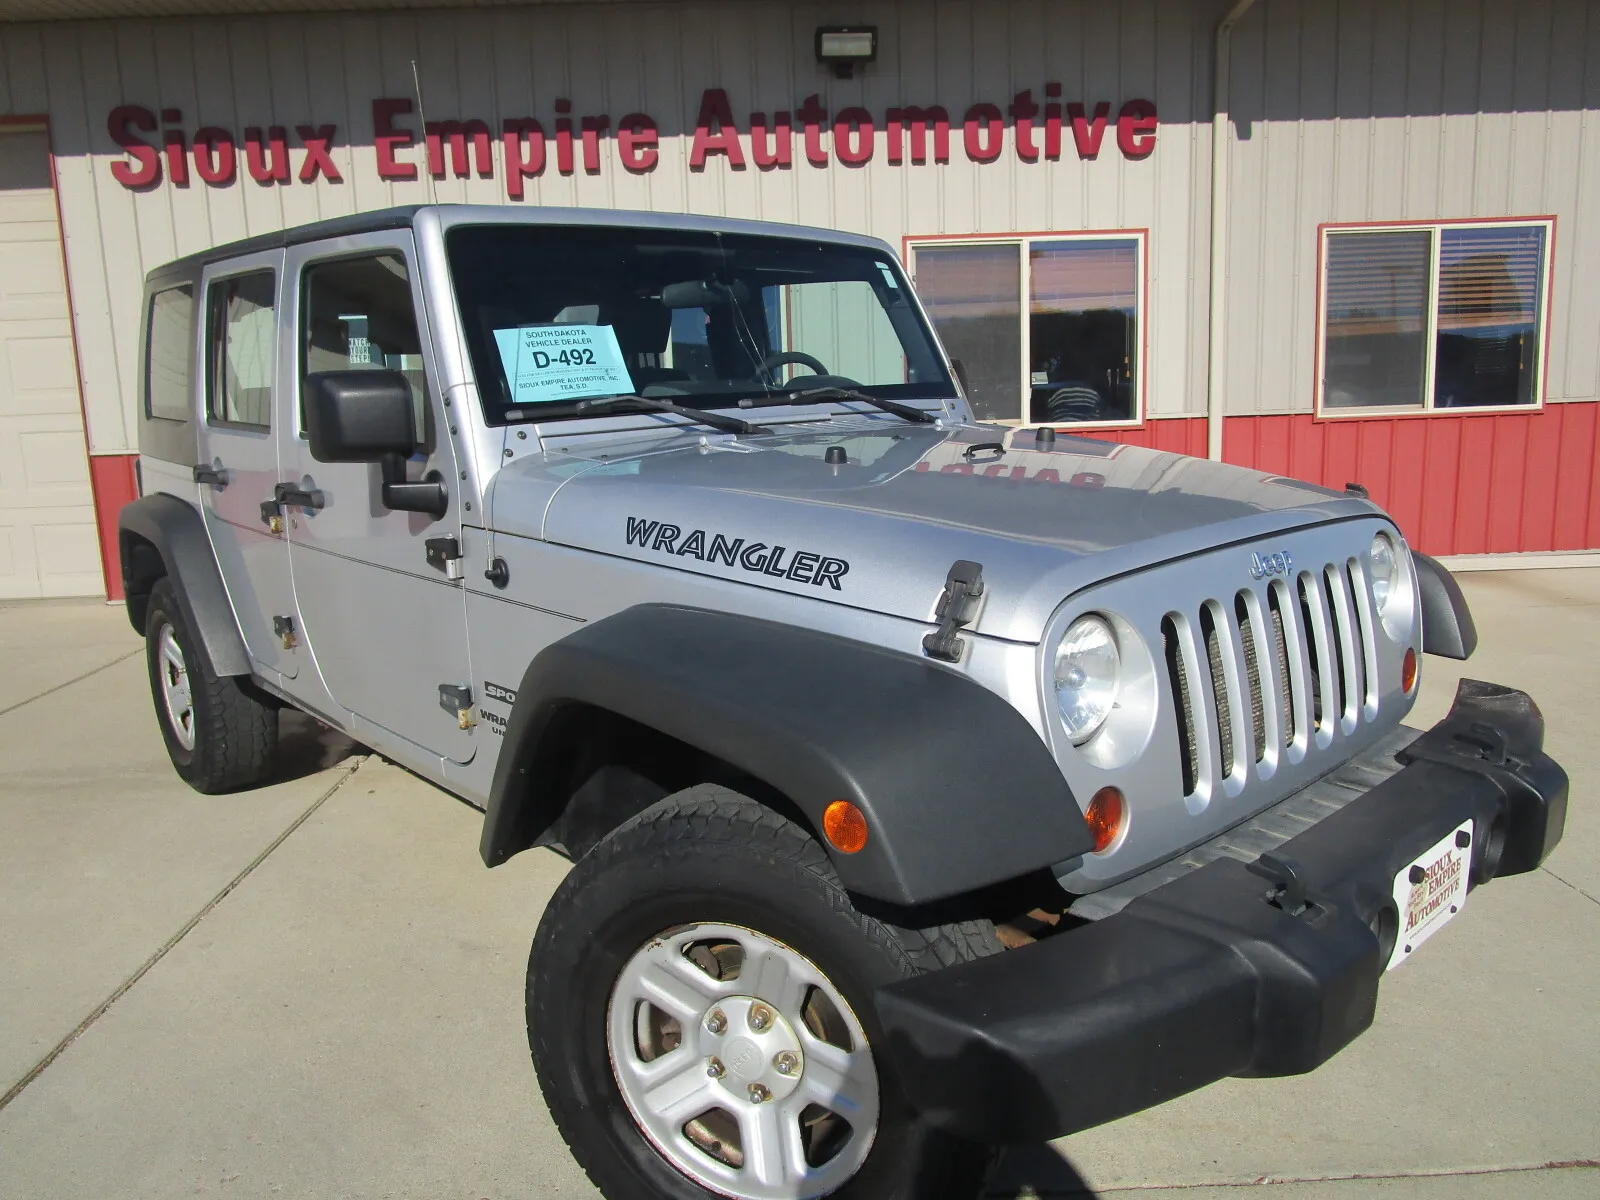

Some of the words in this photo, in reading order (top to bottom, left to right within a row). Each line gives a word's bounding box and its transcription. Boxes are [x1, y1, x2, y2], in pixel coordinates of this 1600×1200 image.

[107, 105, 344, 191] Sioux
[372, 98, 659, 201] Empire
[689, 82, 1158, 172] Automotive
[525, 331, 553, 339] SOUTH
[554, 329, 587, 337] DAKOTA
[525, 339, 560, 348] VEHICLE
[561, 338, 593, 346] DEALER
[532, 348, 597, 369] D-492
[518, 381, 540, 389] SIOUX
[540, 378, 566, 387] EMPIRE
[626, 517, 850, 590] WRANGLER
[1249, 550, 1292, 581] Jeep
[485, 685, 516, 703] SPO
[1424, 850, 1453, 883] SIOUX
[1428, 857, 1461, 896] EMPIRE
[1405, 877, 1460, 934] AUTOMOTIVE
